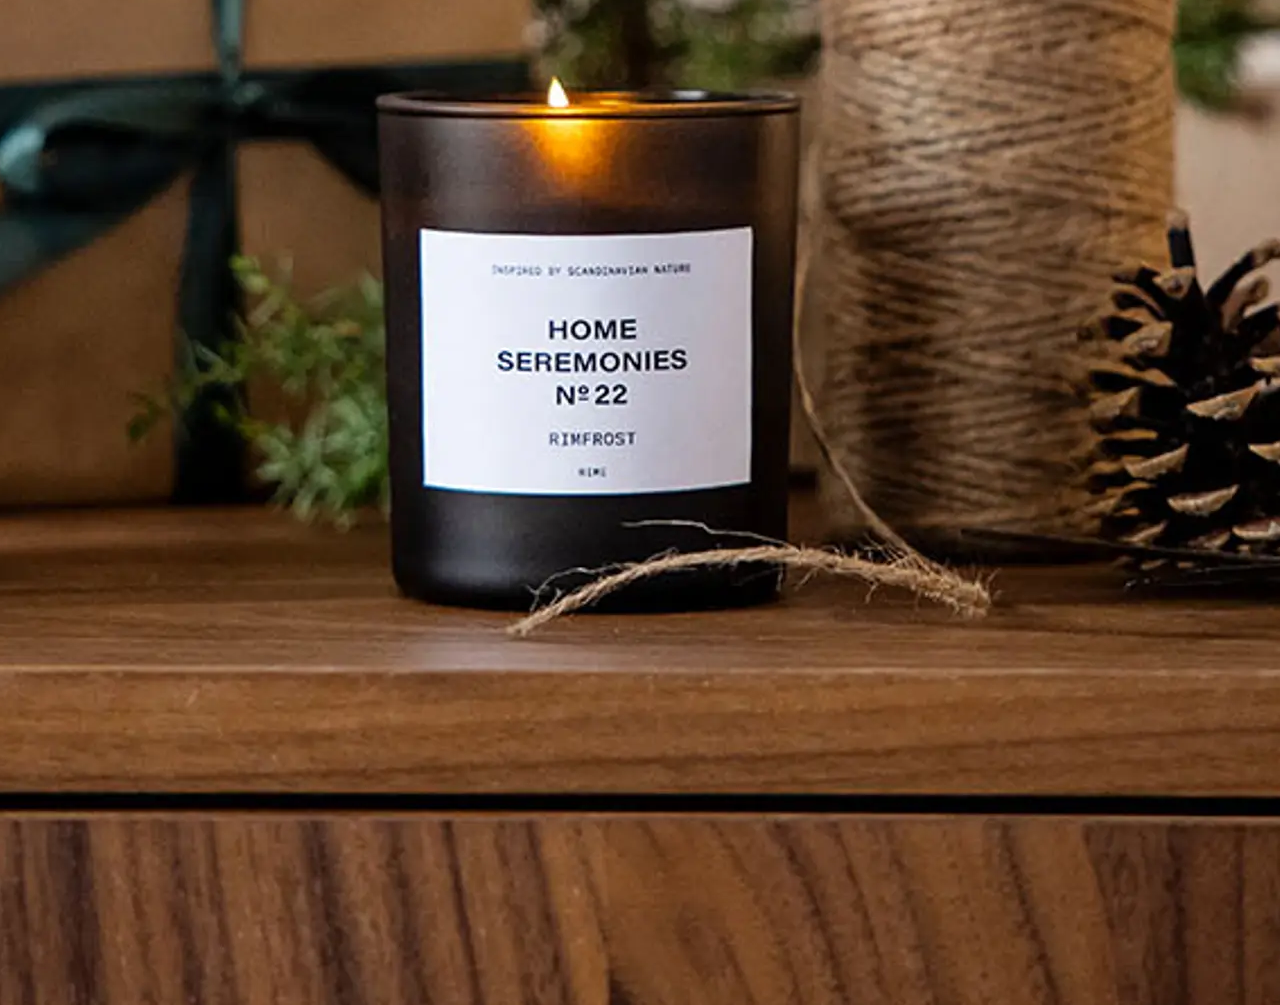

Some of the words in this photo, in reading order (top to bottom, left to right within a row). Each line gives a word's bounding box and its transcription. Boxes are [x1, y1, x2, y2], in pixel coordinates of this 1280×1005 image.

[492, 265, 541, 276] INSPIRED
[548, 266, 562, 276] BY
[568, 265, 648, 276] SCANDINAVIAN
[654, 264, 691, 274] NATURE
[549, 319, 637, 340] HOME
[497, 349, 687, 371] SEREMONIES
[549, 432, 636, 446] RIMFROST
